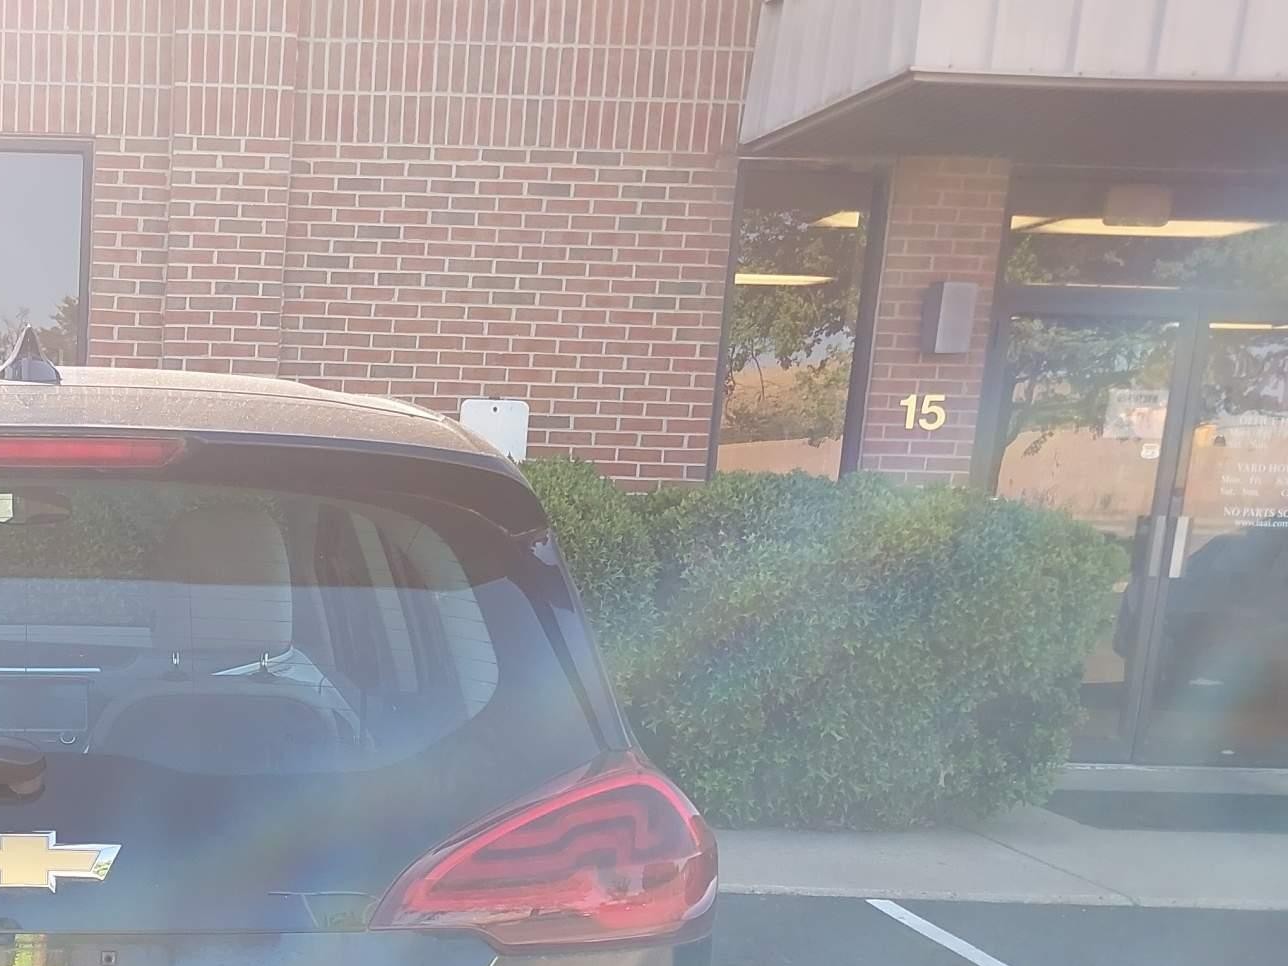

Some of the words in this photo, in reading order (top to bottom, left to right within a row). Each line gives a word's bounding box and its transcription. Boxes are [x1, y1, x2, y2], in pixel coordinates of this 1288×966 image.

[899, 394, 946, 431] 15
[1223, 506, 1241, 517] NO
[1242, 507, 1275, 518] PARTS
